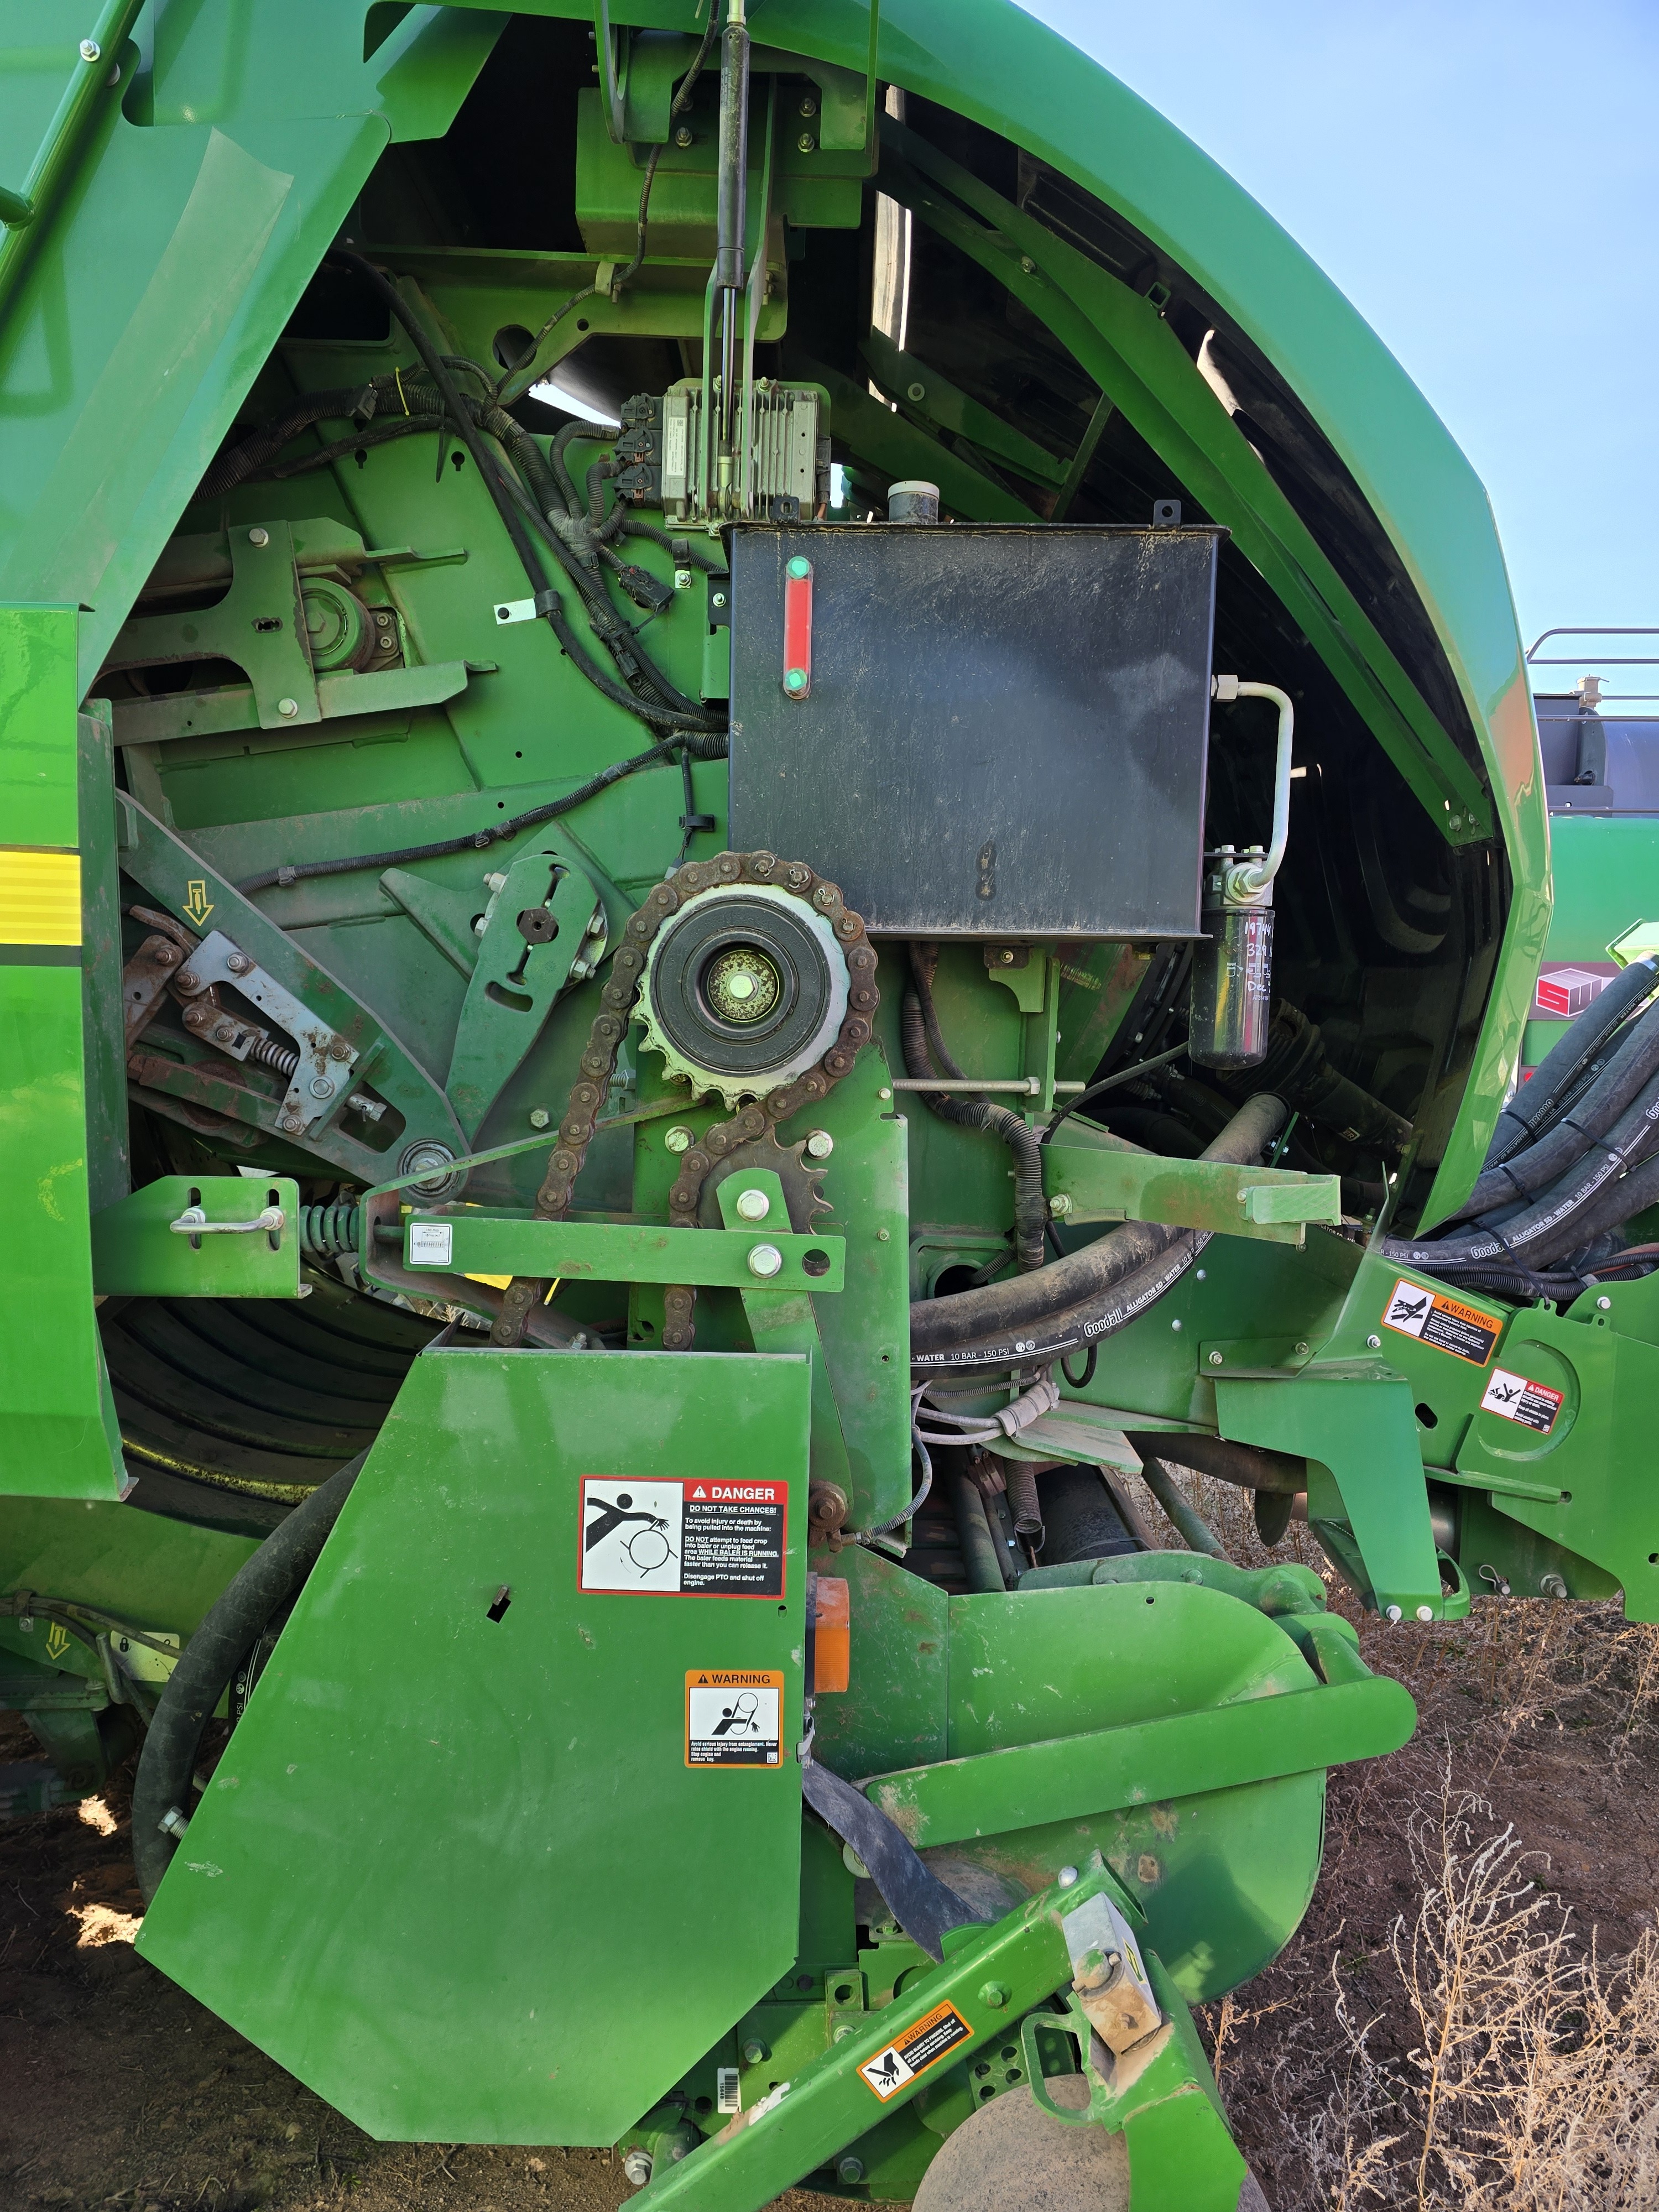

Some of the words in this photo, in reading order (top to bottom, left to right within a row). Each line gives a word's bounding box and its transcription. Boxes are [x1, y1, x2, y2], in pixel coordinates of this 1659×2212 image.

[1620, 1003, 1636, 1019] WATER
[1563, 1091, 1572, 1102] BAR
[1574, 1081, 1583, 1089] 150
[1582, 1074, 1591, 1083] PSI
[1528, 1099, 1554, 1129] Goodall
[1512, 1221, 1545, 1242] ALLIGATOR
[1543, 1215, 1553, 1224] SD
[1553, 1199, 1575, 1217] WATER
[1580, 1182, 1593, 1194] BAR
[1593, 1171, 1604, 1182] 150
[1602, 1164, 1610, 1173] PSI
[1470, 1238, 1509, 1259] Goodal
[1083, 1307, 1123, 1337] Goodall
[1126, 1287, 1156, 1312] ALLIGATOR
[1155, 1281, 1164, 1290] SD
[1164, 1264, 1181, 1284] WATER
[1182, 1256, 1188, 1265] 10
[1451, 1303, 1493, 1328] WARNING
[1535, 1387, 1559, 1401] DANGER
[712, 1487, 775, 1500] DANGER
[712, 1674, 770, 1684] WARNING
[909, 2013, 943, 2038] WARNING
